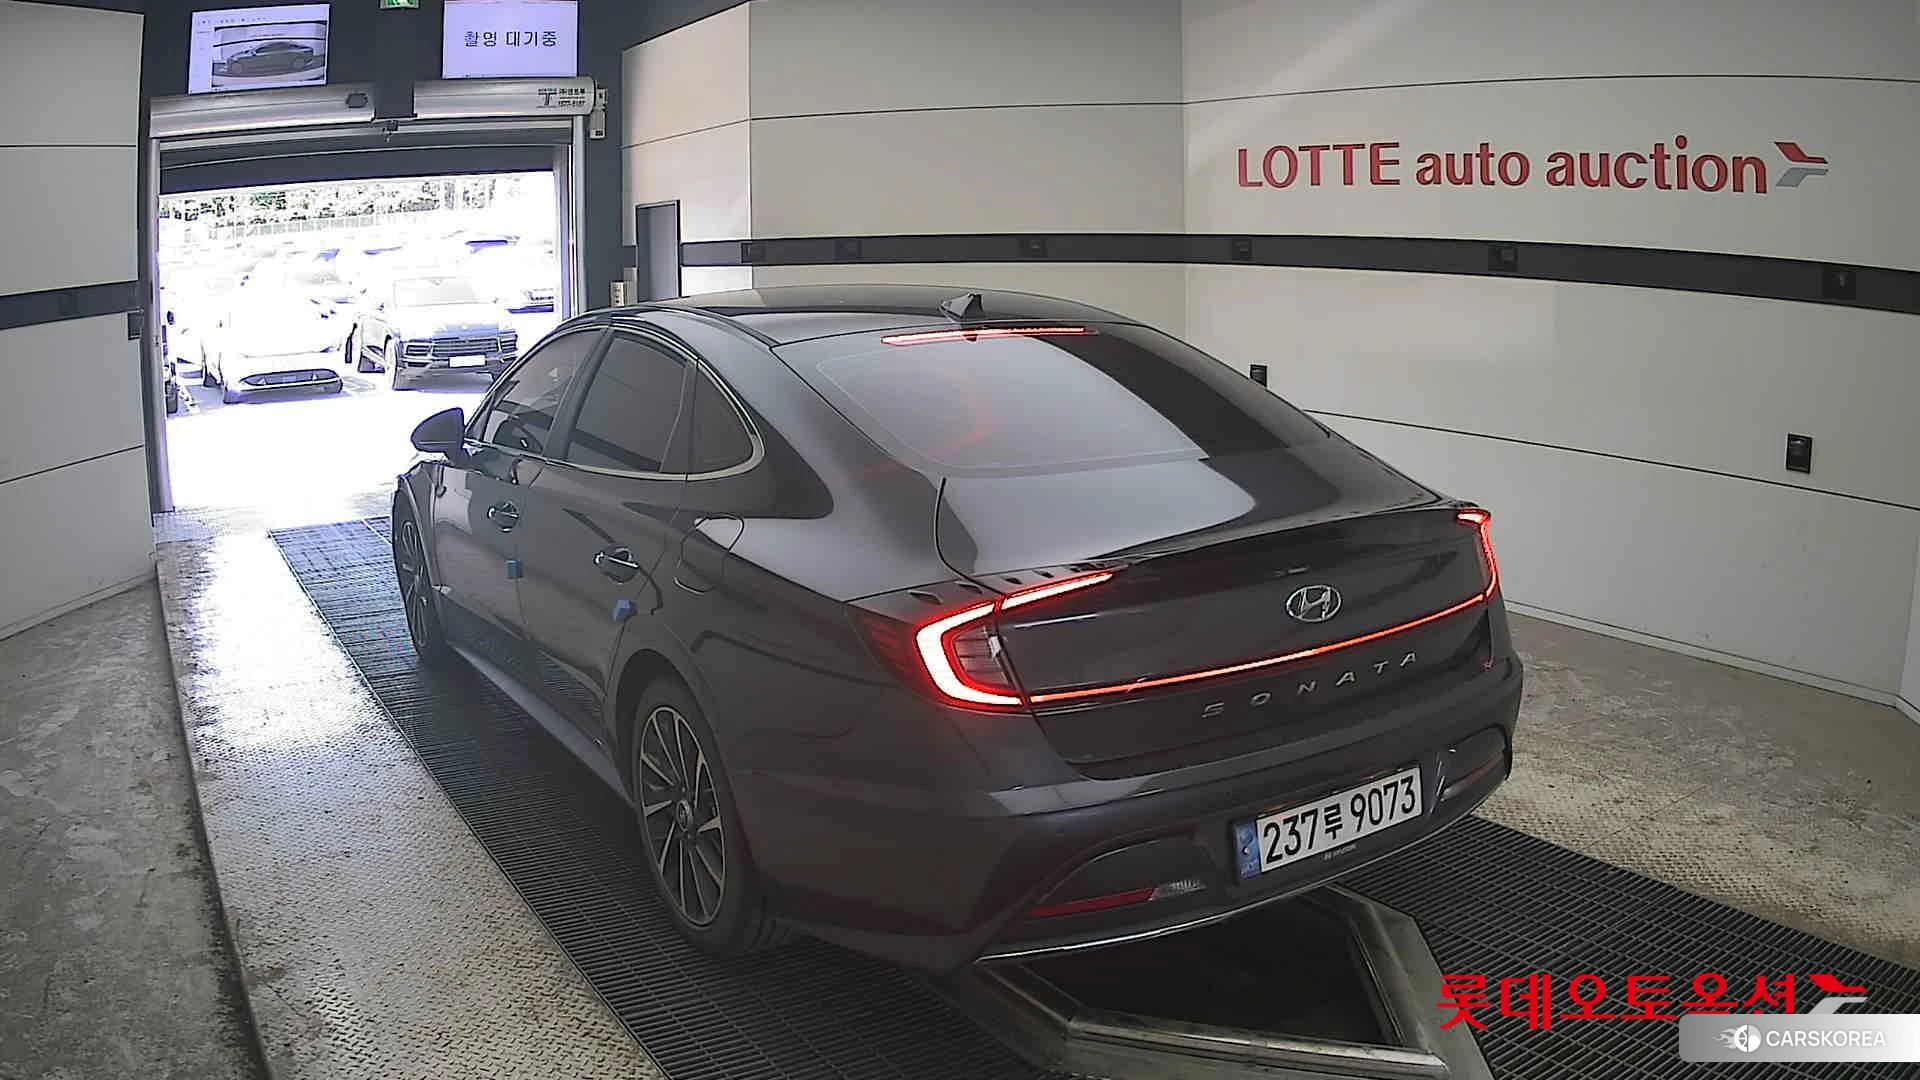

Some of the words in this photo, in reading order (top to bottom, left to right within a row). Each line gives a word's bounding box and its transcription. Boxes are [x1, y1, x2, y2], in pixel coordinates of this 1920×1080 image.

[464, 31, 497, 47] 촬영
[506, 31, 557, 47] 대기중
[1238, 143, 1400, 188] LOTTE
[1416, 143, 1530, 186] auto
[1546, 136, 1767, 193] auction
[1201, 651, 1417, 718] SONATA
[1263, 803, 1343, 864] 237루
[1350, 776, 1416, 832] 9073
